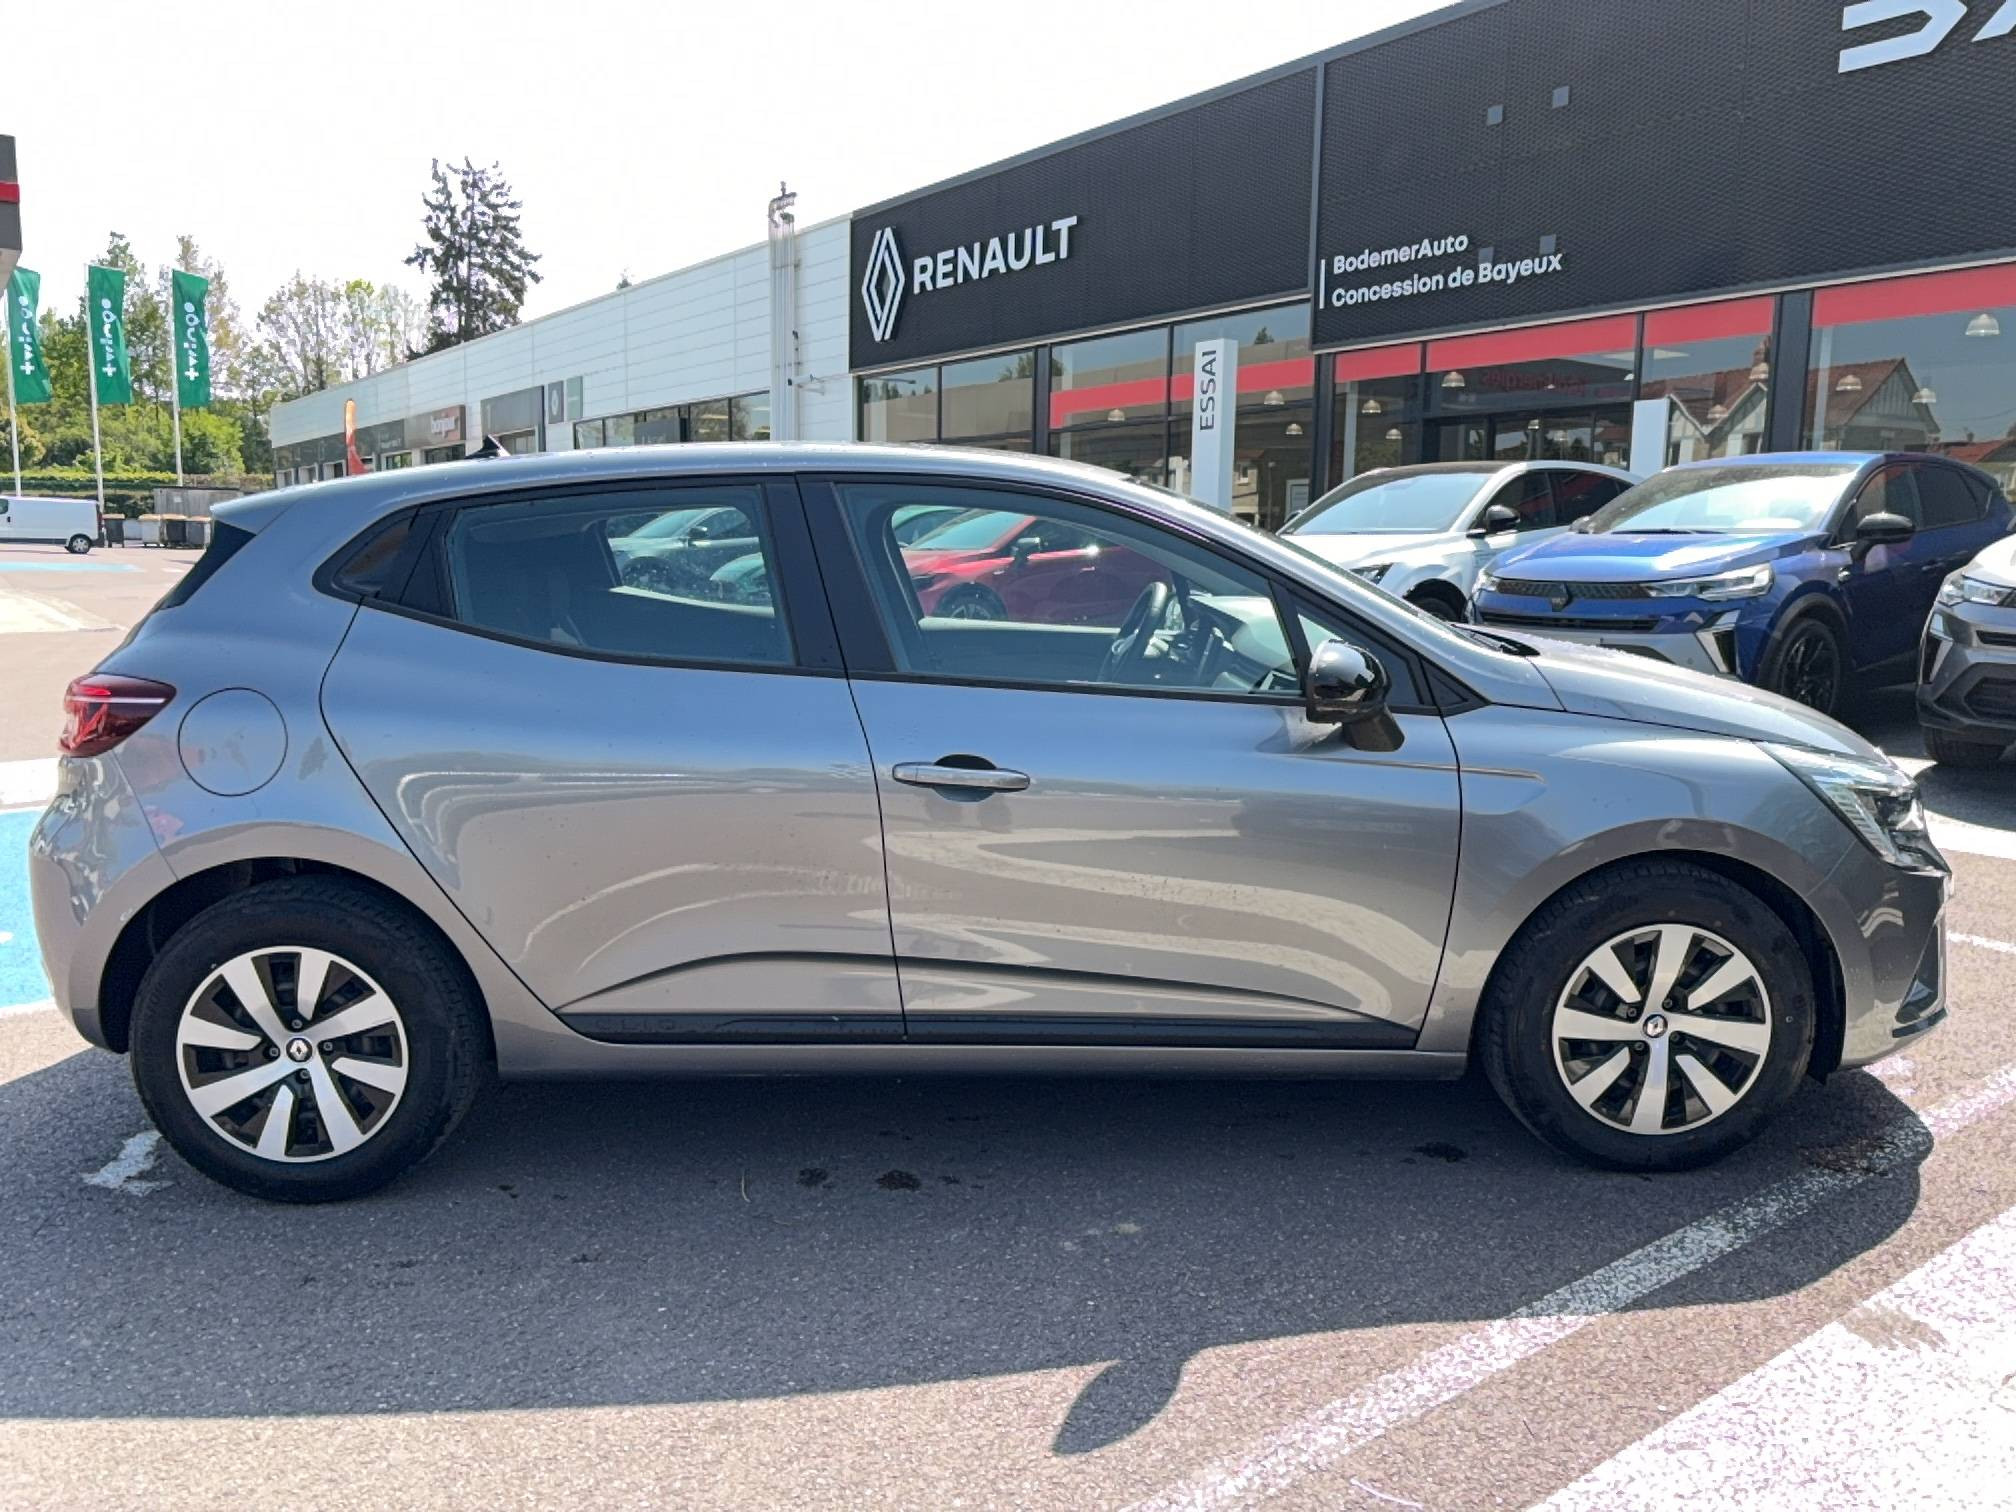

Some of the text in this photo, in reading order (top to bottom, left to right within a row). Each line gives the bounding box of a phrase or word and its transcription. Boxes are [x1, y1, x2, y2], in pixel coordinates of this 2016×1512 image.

[913, 215, 1078, 295] RENAULT
[1331, 252, 1563, 307] Concession de Bayeux
[1333, 234, 1469, 275] BodemerAuto
[1199, 349, 1217, 431] ESSAI
